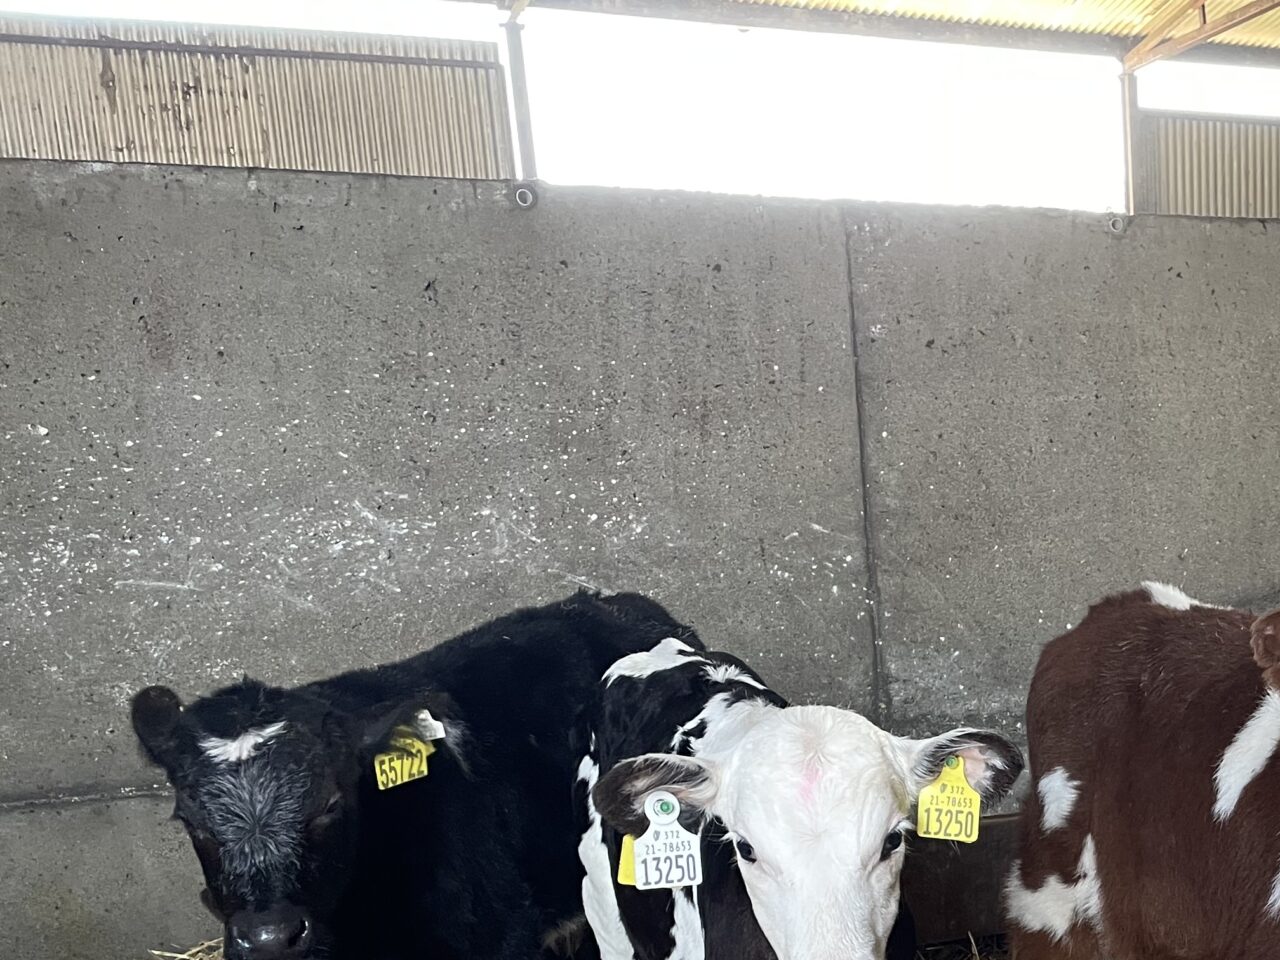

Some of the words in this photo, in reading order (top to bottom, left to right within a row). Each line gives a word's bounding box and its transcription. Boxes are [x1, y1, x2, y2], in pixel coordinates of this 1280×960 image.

[950, 786, 965, 795] 372
[923, 807, 974, 839] 13250
[664, 830, 680, 840] 372
[641, 853, 697, 886] 13250
